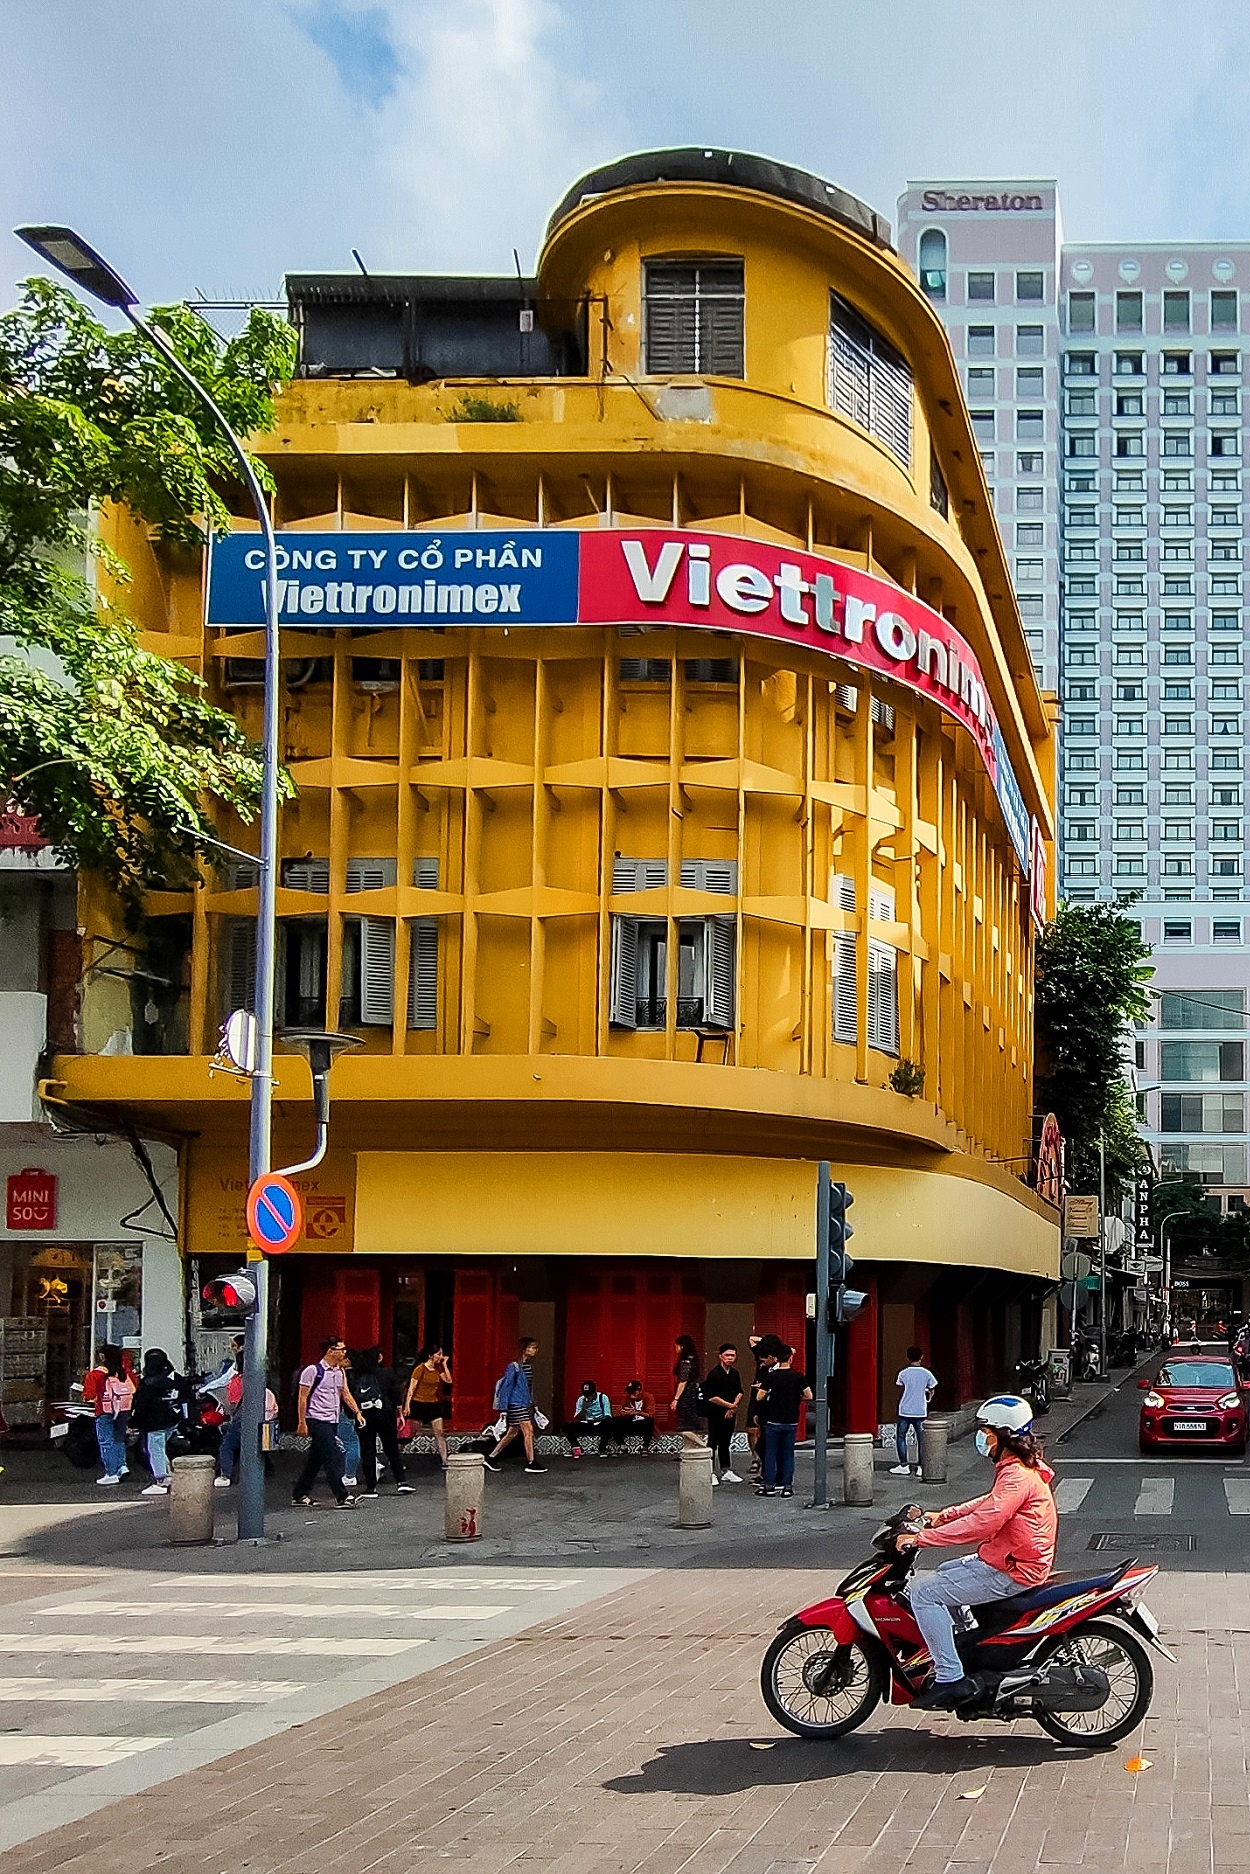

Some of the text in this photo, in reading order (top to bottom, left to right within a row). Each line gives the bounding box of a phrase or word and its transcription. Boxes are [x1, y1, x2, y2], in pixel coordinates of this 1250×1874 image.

[922, 191, 1043, 211] Sheraton
[245, 539, 542, 570] CÔNG TY CỔ PHẦN
[261, 580, 521, 613] Viettronimex
[13, 1190, 49, 1203] MINI
[1139, 1180, 1149, 1239] ANPHA
